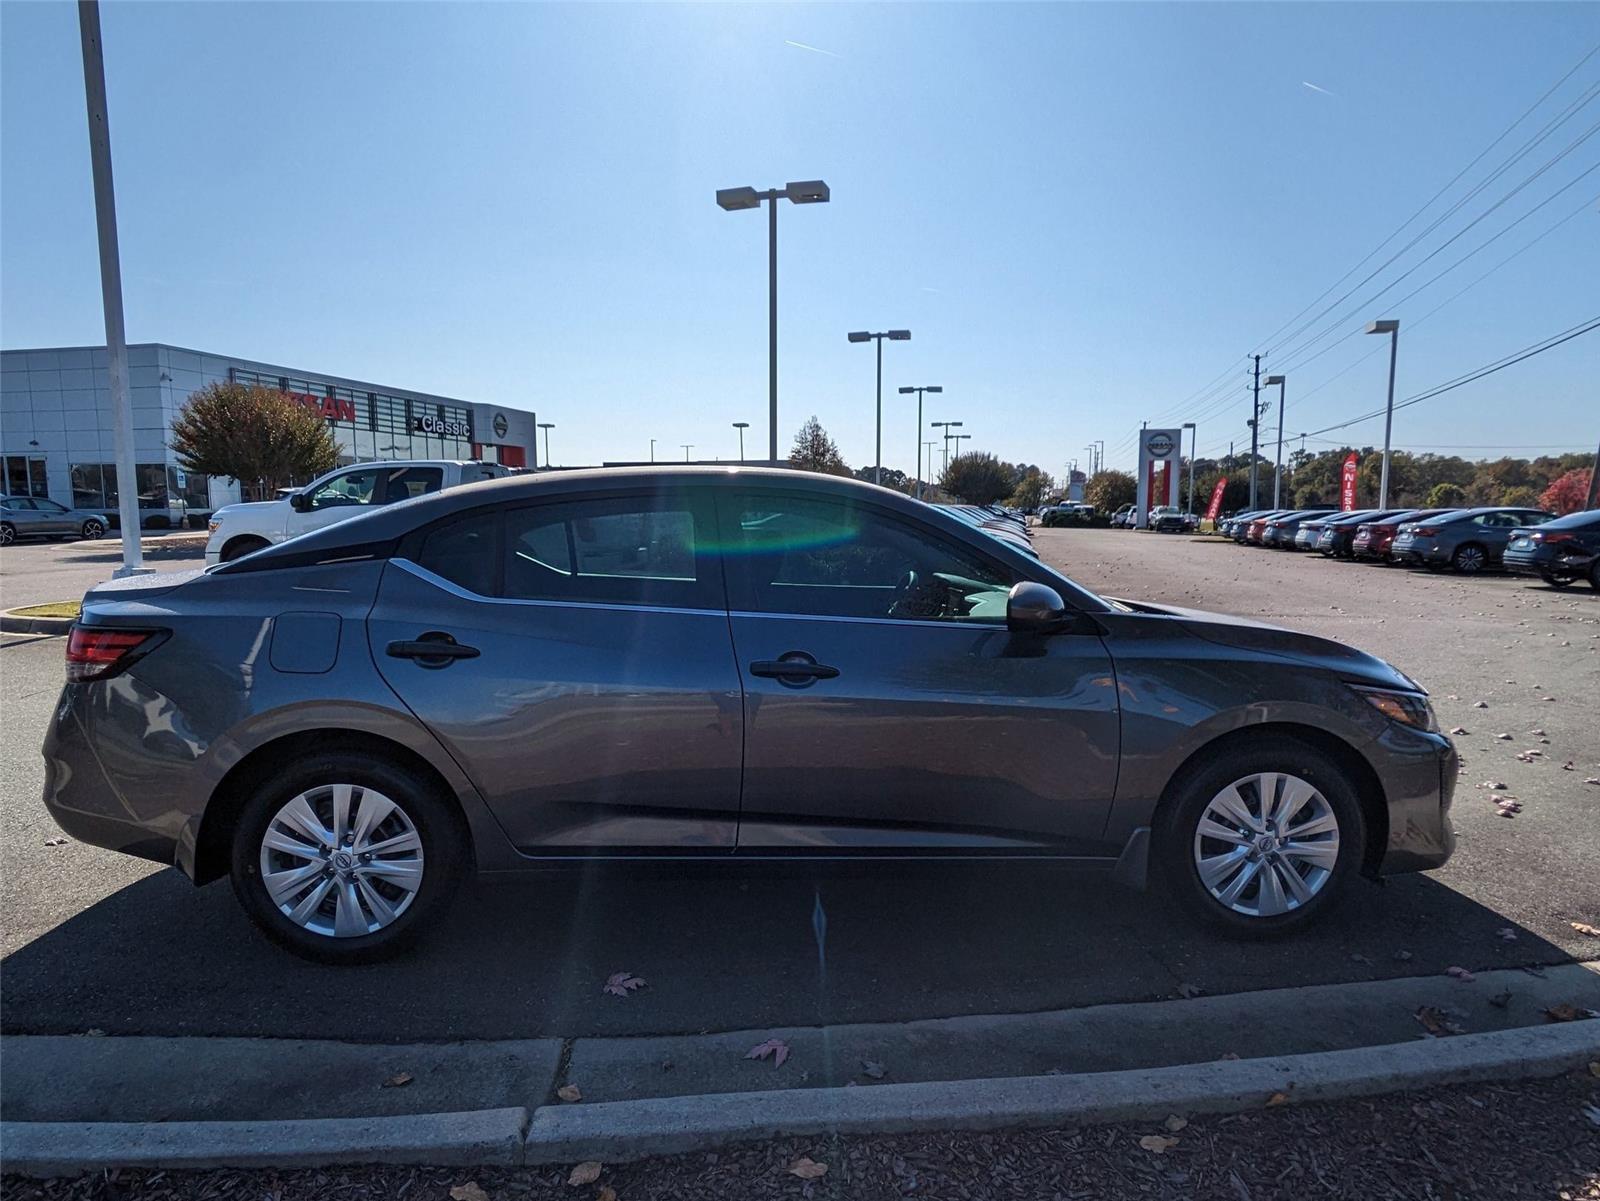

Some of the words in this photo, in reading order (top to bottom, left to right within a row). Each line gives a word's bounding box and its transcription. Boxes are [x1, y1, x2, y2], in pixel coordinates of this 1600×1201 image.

[286, 392, 356, 422] SAN
[422, 416, 470, 437] Classic
[1344, 473, 1354, 512] NISSA
